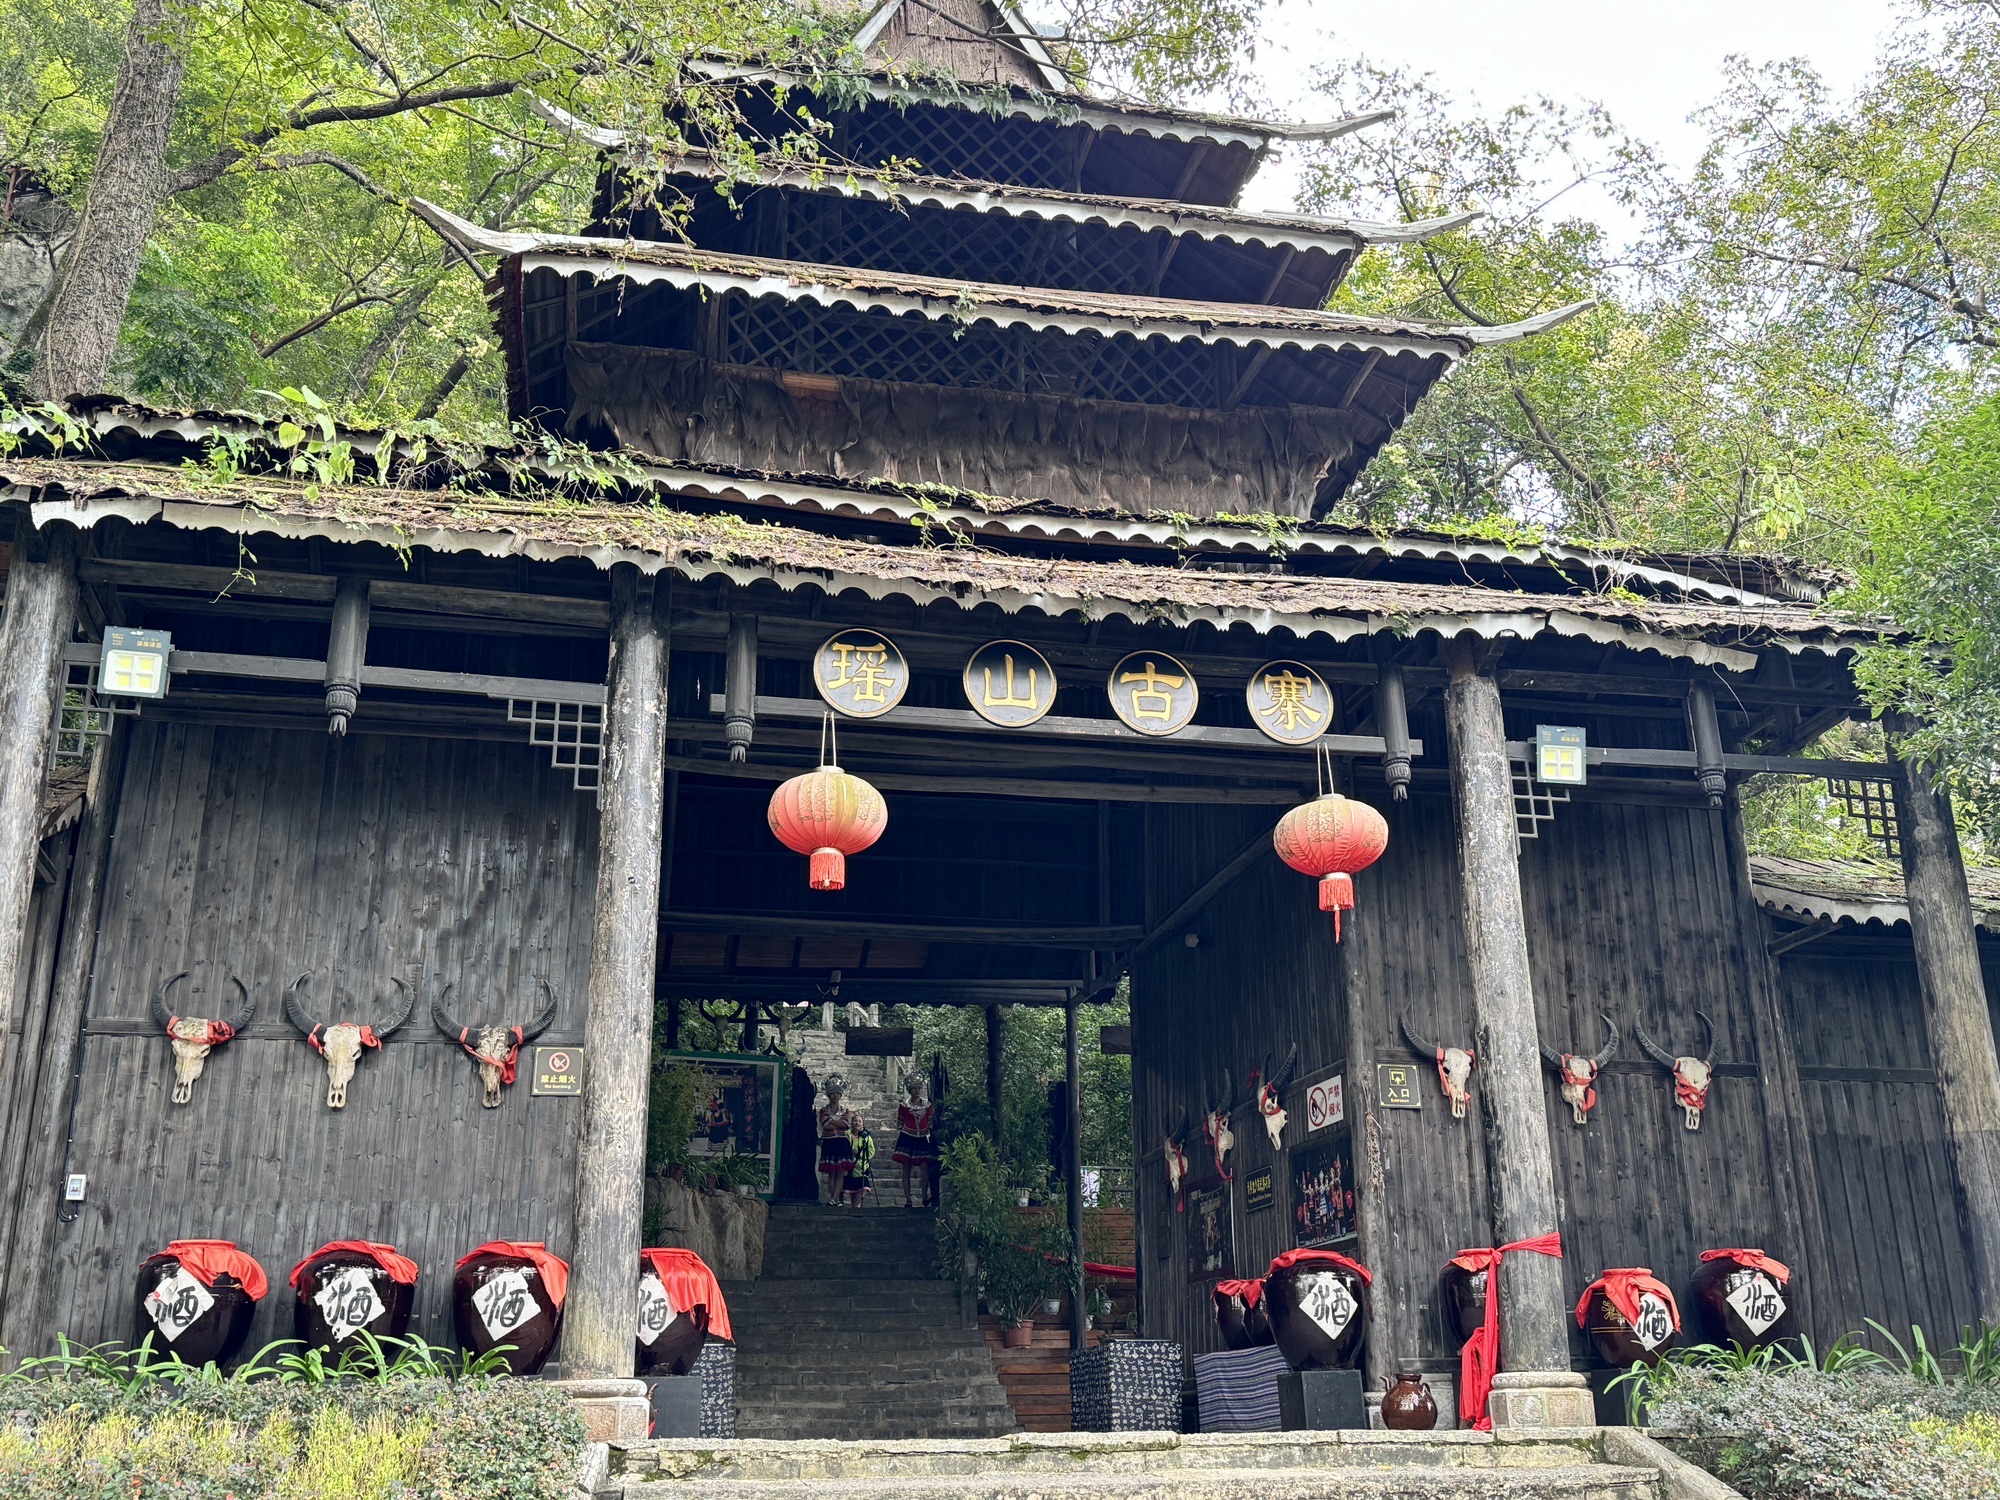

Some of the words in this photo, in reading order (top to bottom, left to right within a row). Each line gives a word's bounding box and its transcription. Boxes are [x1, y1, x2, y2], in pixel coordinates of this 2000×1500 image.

[827, 641, 1322, 732] 瑶山古寨
[541, 1075, 576, 1083] 禁止烟火
[1328, 1084, 1340, 1100] 严禁
[1387, 1087, 1410, 1098] 入口
[154, 1286, 199, 1327] 酒
[326, 1281, 372, 1327] 酒
[482, 1281, 527, 1328] 酒
[1312, 1284, 1351, 1327] 酒
[1637, 1299, 1668, 1341] 酒
[1742, 1283, 1777, 1322] 酒
